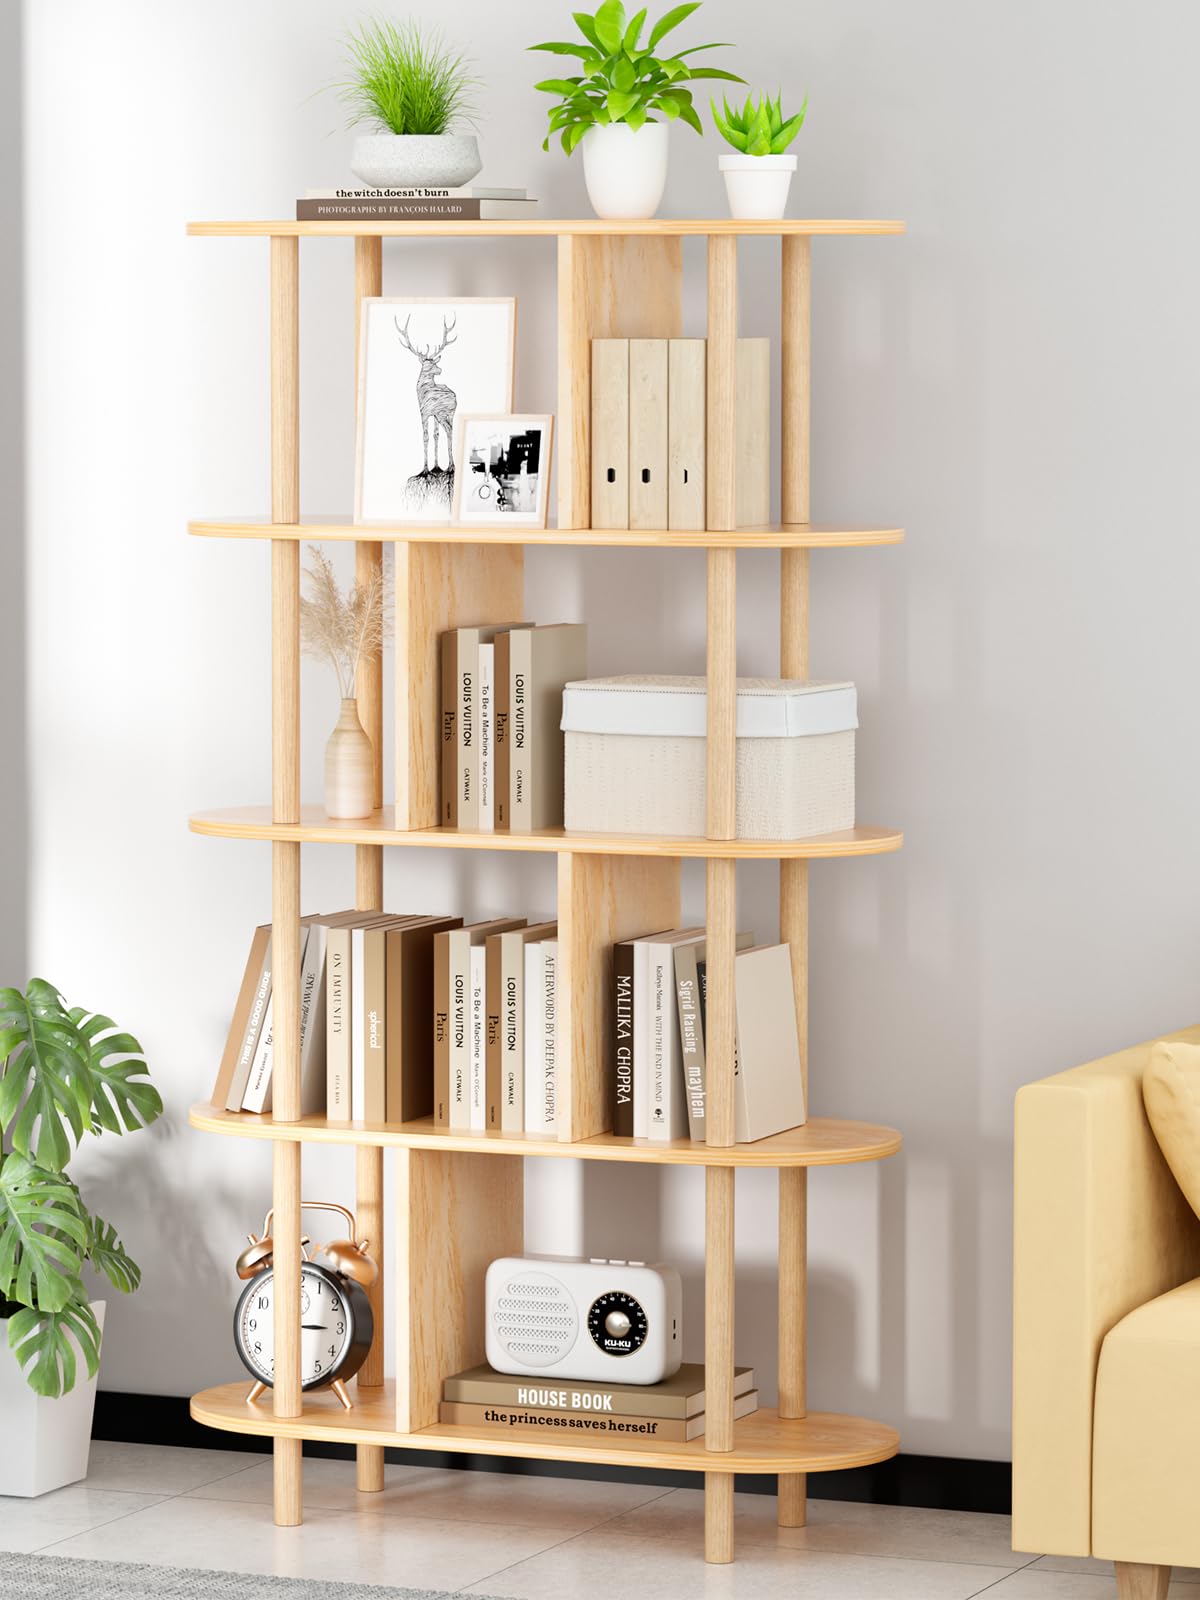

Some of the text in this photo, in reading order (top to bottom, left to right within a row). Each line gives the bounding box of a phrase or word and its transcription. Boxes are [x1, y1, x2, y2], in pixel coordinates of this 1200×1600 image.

[336, 188, 449, 198] the witch doesn't burn
[318, 205, 463, 215] PHOTOGRAPHS BY FRANÇOIS HALARD
[463, 673, 472, 702] LOUIS
[481, 685, 489, 696] To
[515, 674, 524, 704] LOUIS
[482, 698, 490, 710] Be
[444, 711, 455, 741] Paris
[463, 704, 472, 747] VUITTON
[497, 712, 507, 743] Paris
[515, 706, 524, 749] VUITTON
[482, 720, 490, 757] Machine
[333, 953, 341, 968] ON
[303, 972, 316, 1006] AWAKE
[455, 975, 464, 1004] LOUIS
[474, 988, 481, 997] To
[507, 977, 516, 1007] LOUIS
[333, 974, 341, 1033] IMMUNITY
[474, 1000, 482, 1011] Be
[240, 1045, 252, 1065] THIS
[246, 1035, 255, 1046] IS
[251, 1001, 264, 1027] GOOD
[258, 970, 272, 999] GUIDE
[436, 1012, 447, 1042] Paris
[455, 1006, 464, 1048] VUITTON
[655, 1015, 663, 1036] WITH
[367, 1010, 382, 1049] spherical
[474, 1022, 482, 1059] Machine
[488, 1015, 499, 1045] Paris
[507, 1009, 516, 1051] VUITTON
[545, 955, 555, 1122] AFTERWORD BY DEEPAK CHOPRA
[617, 975, 632, 1105] MALLIKA CHOPRA
[655, 1037, 663, 1051] THE
[679, 980, 707, 1118] Sigrid Rausing mayhem
[655, 1053, 663, 1070] END
[655, 1071, 663, 1080] IN
[655, 1081, 663, 1102] MIND
[316, 1281, 322, 1294] 1
[258, 1297, 269, 1310] 10
[331, 1299, 339, 1312] 2
[249, 1319, 257, 1332] 9
[336, 1322, 344, 1335] 3
[254, 1341, 262, 1354] 8
[328, 1345, 336, 1356] 4
[604, 1339, 631, 1348] KU-KU
[314, 1360, 322, 1373] 5
[517, 1388, 613, 1411] HOUSE BOOK
[484, 1410, 658, 1434] the princess saves herself
